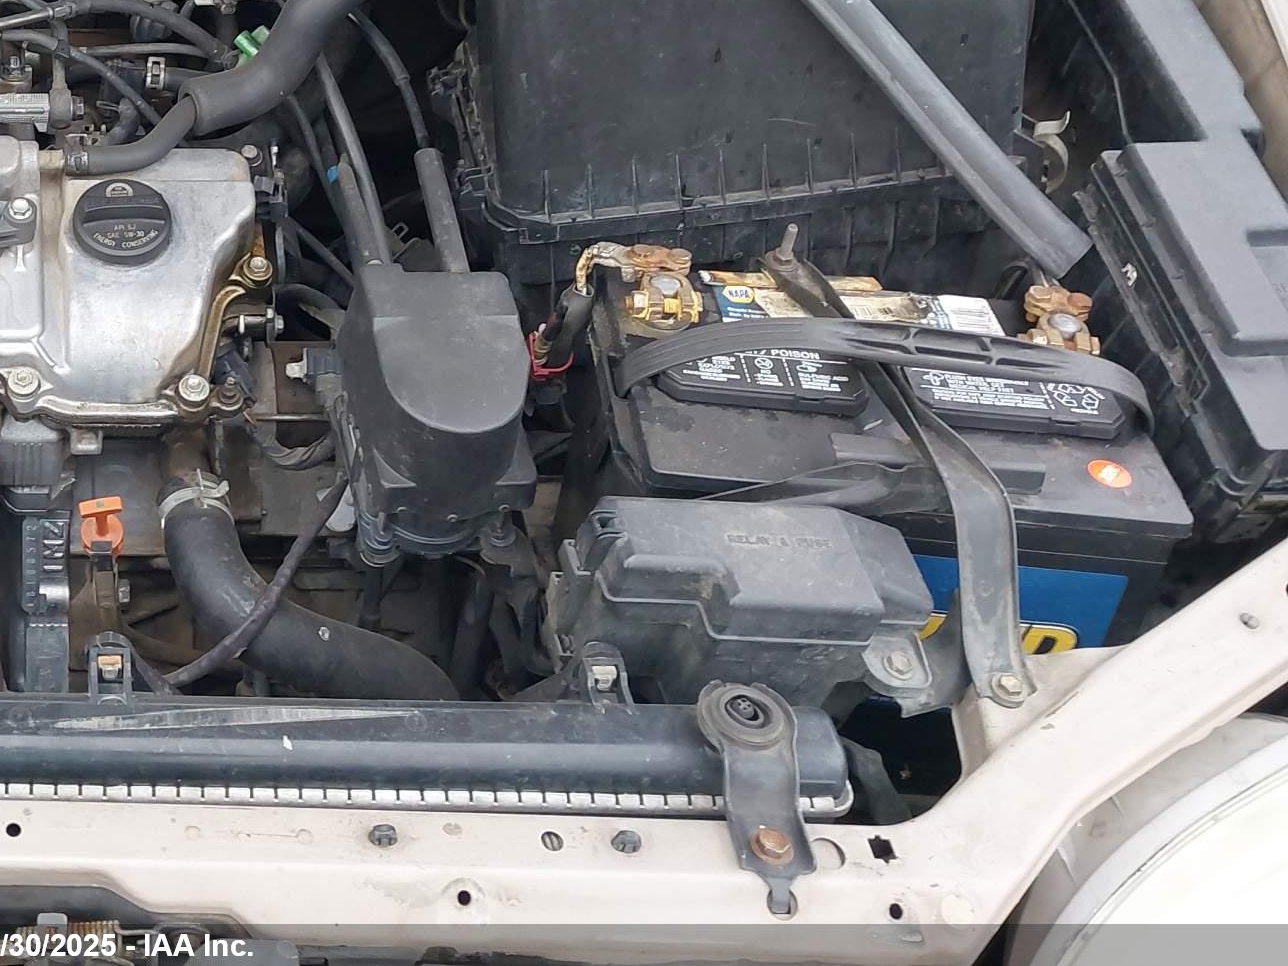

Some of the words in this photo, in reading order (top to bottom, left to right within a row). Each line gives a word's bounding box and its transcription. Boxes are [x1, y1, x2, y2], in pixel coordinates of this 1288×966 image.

[93, 232, 116, 246] ENERGY
[122, 229, 158, 248] CONSERVING
[123, 230, 145, 238] 5W-30
[728, 289, 751, 299] NAPA
[770, 349, 820, 360] POISON
[726, 534, 770, 546] RELAY
